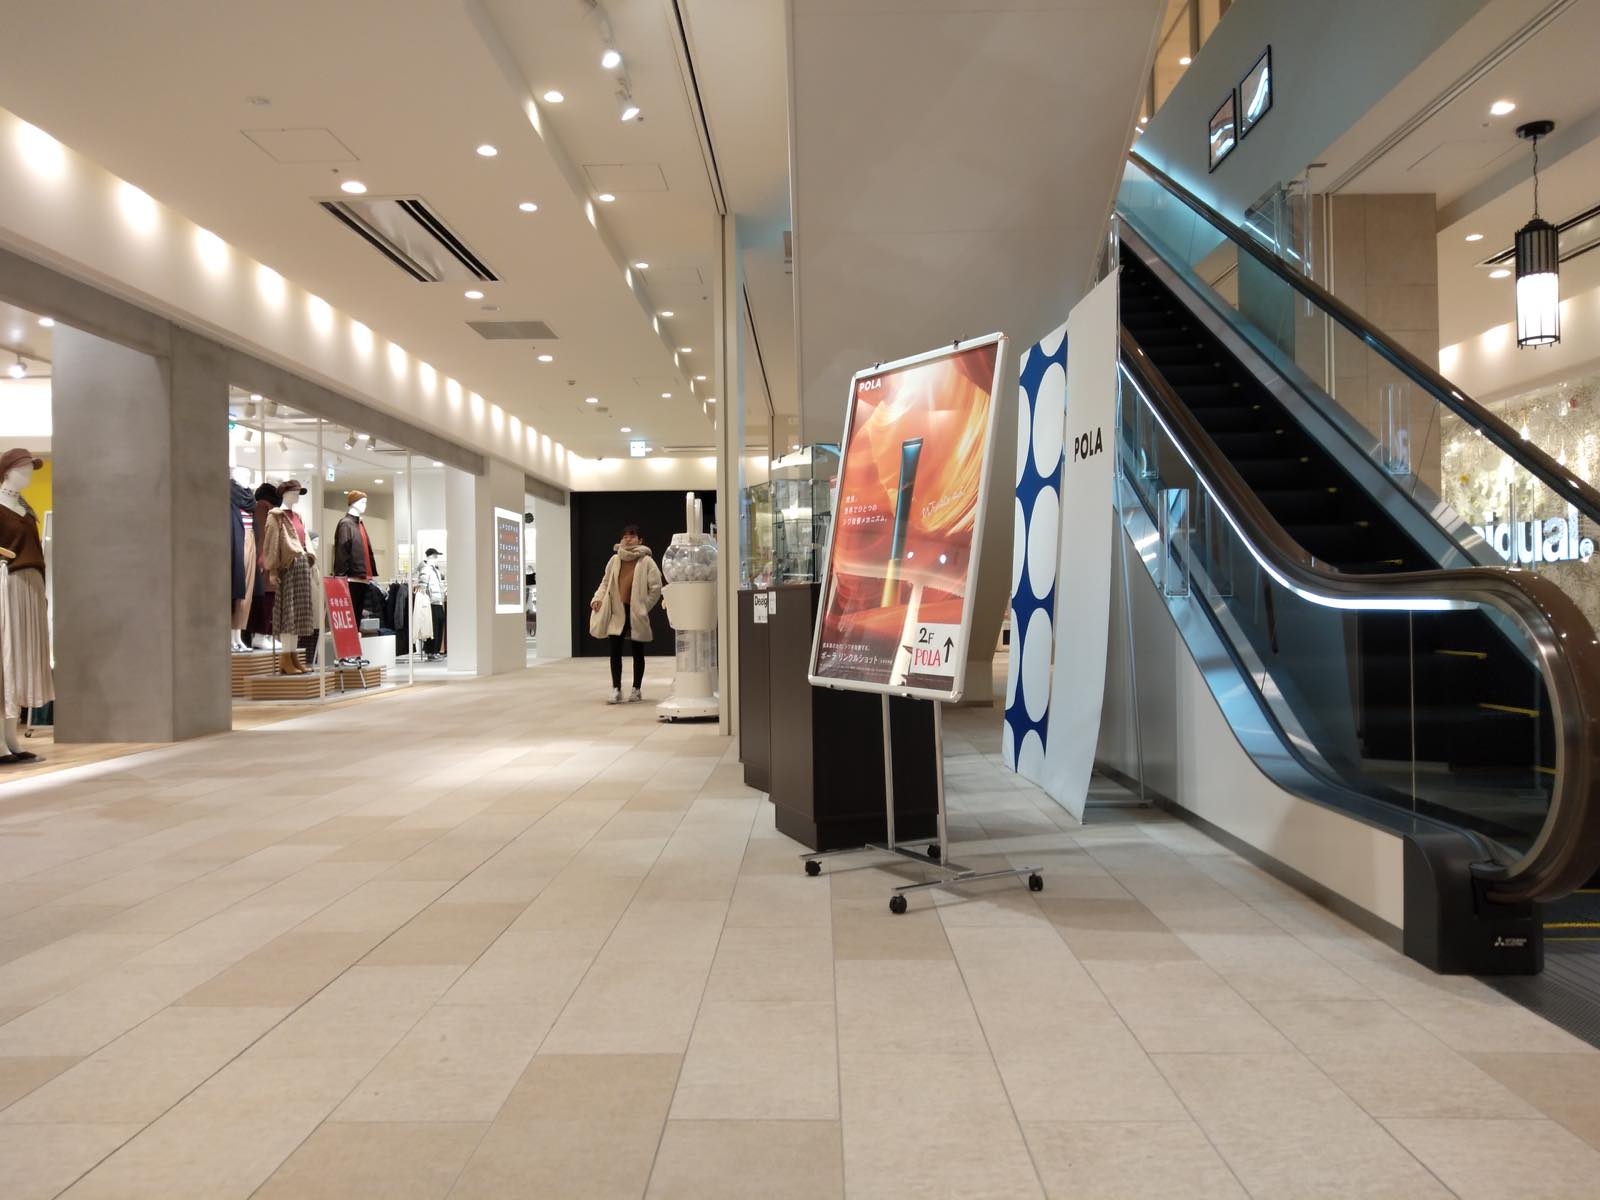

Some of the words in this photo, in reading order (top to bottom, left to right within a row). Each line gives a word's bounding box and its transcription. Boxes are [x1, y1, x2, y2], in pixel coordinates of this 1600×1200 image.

[858, 377, 882, 392] POLA
[1074, 426, 1103, 463] POLA
[332, 610, 353, 630] SALE
[918, 627, 934, 644] 2F
[914, 648, 941, 667] POLA
